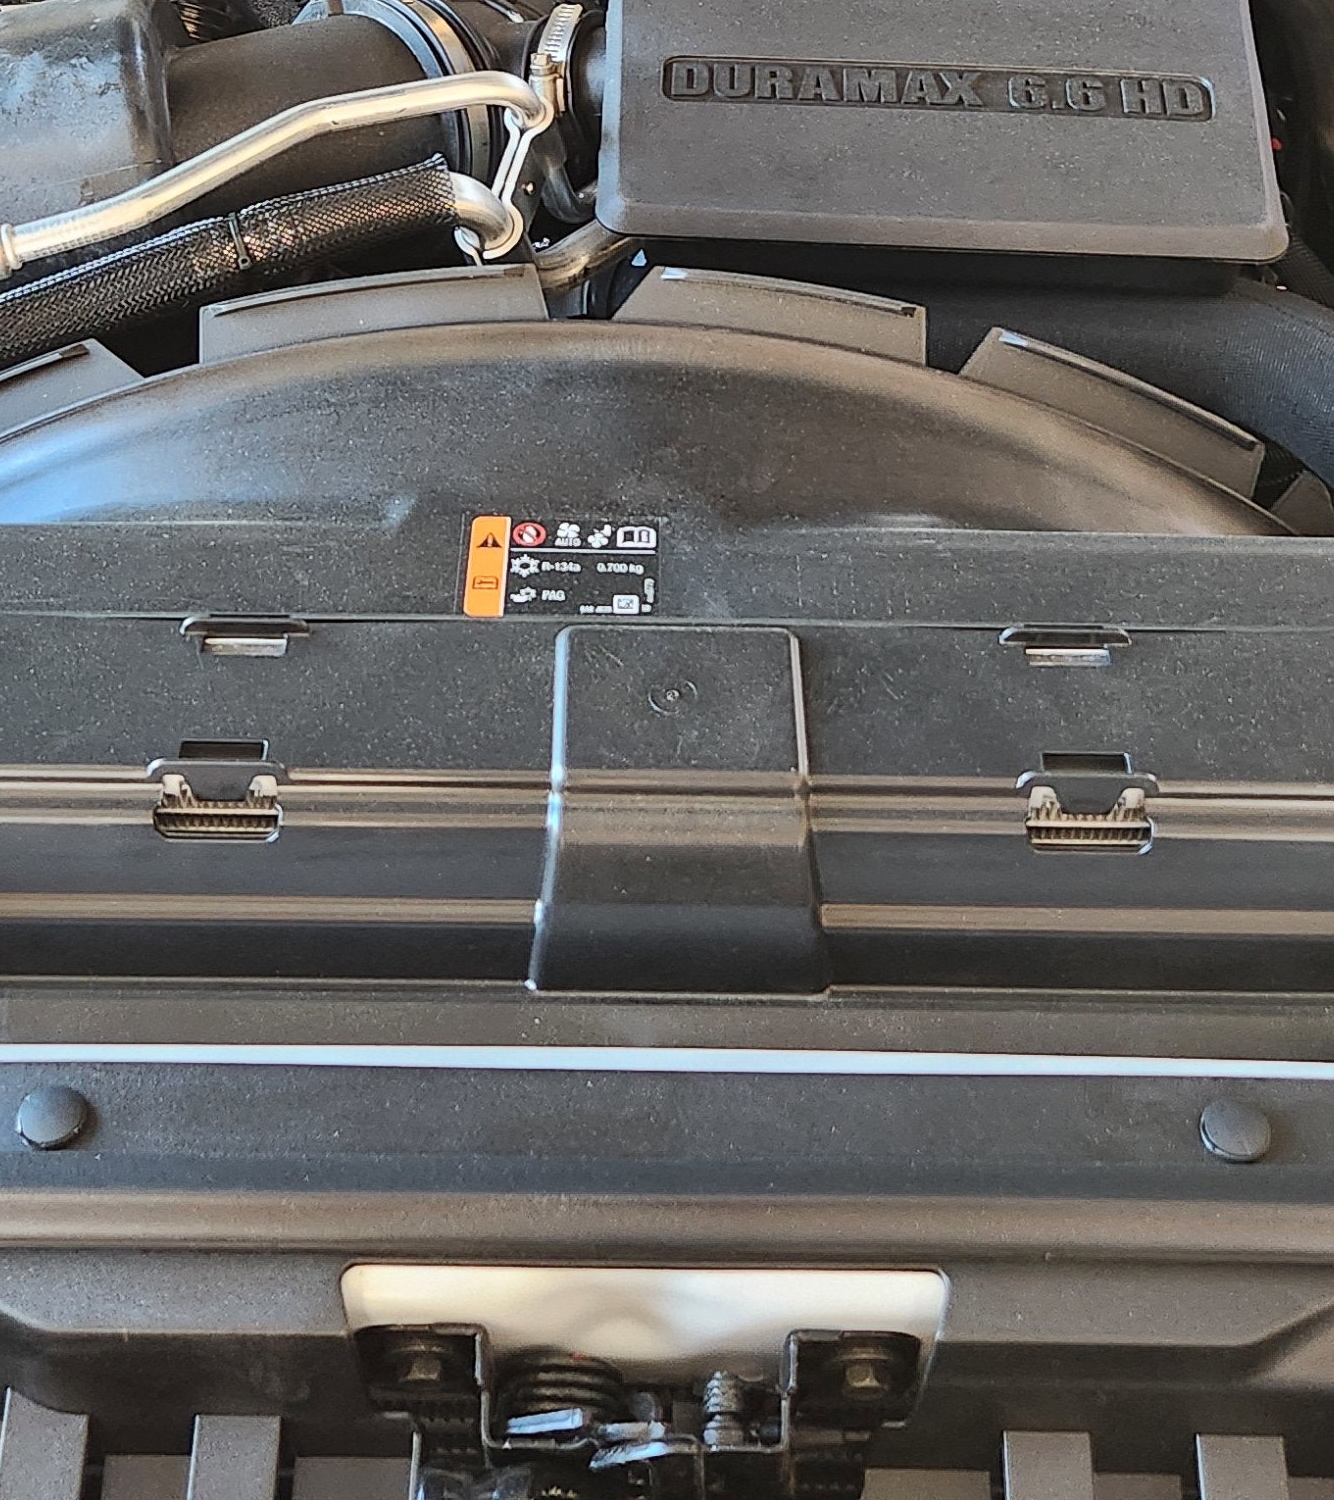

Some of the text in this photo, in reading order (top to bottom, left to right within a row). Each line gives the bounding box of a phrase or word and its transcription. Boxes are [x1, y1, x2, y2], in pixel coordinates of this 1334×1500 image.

[670, 61, 1204, 116] DURAMAX 6.6 HD
[554, 537, 582, 548] AUTO
[541, 561, 582, 573] R-134a
[628, 563, 645, 575] kg
[541, 590, 566, 601] PAG
